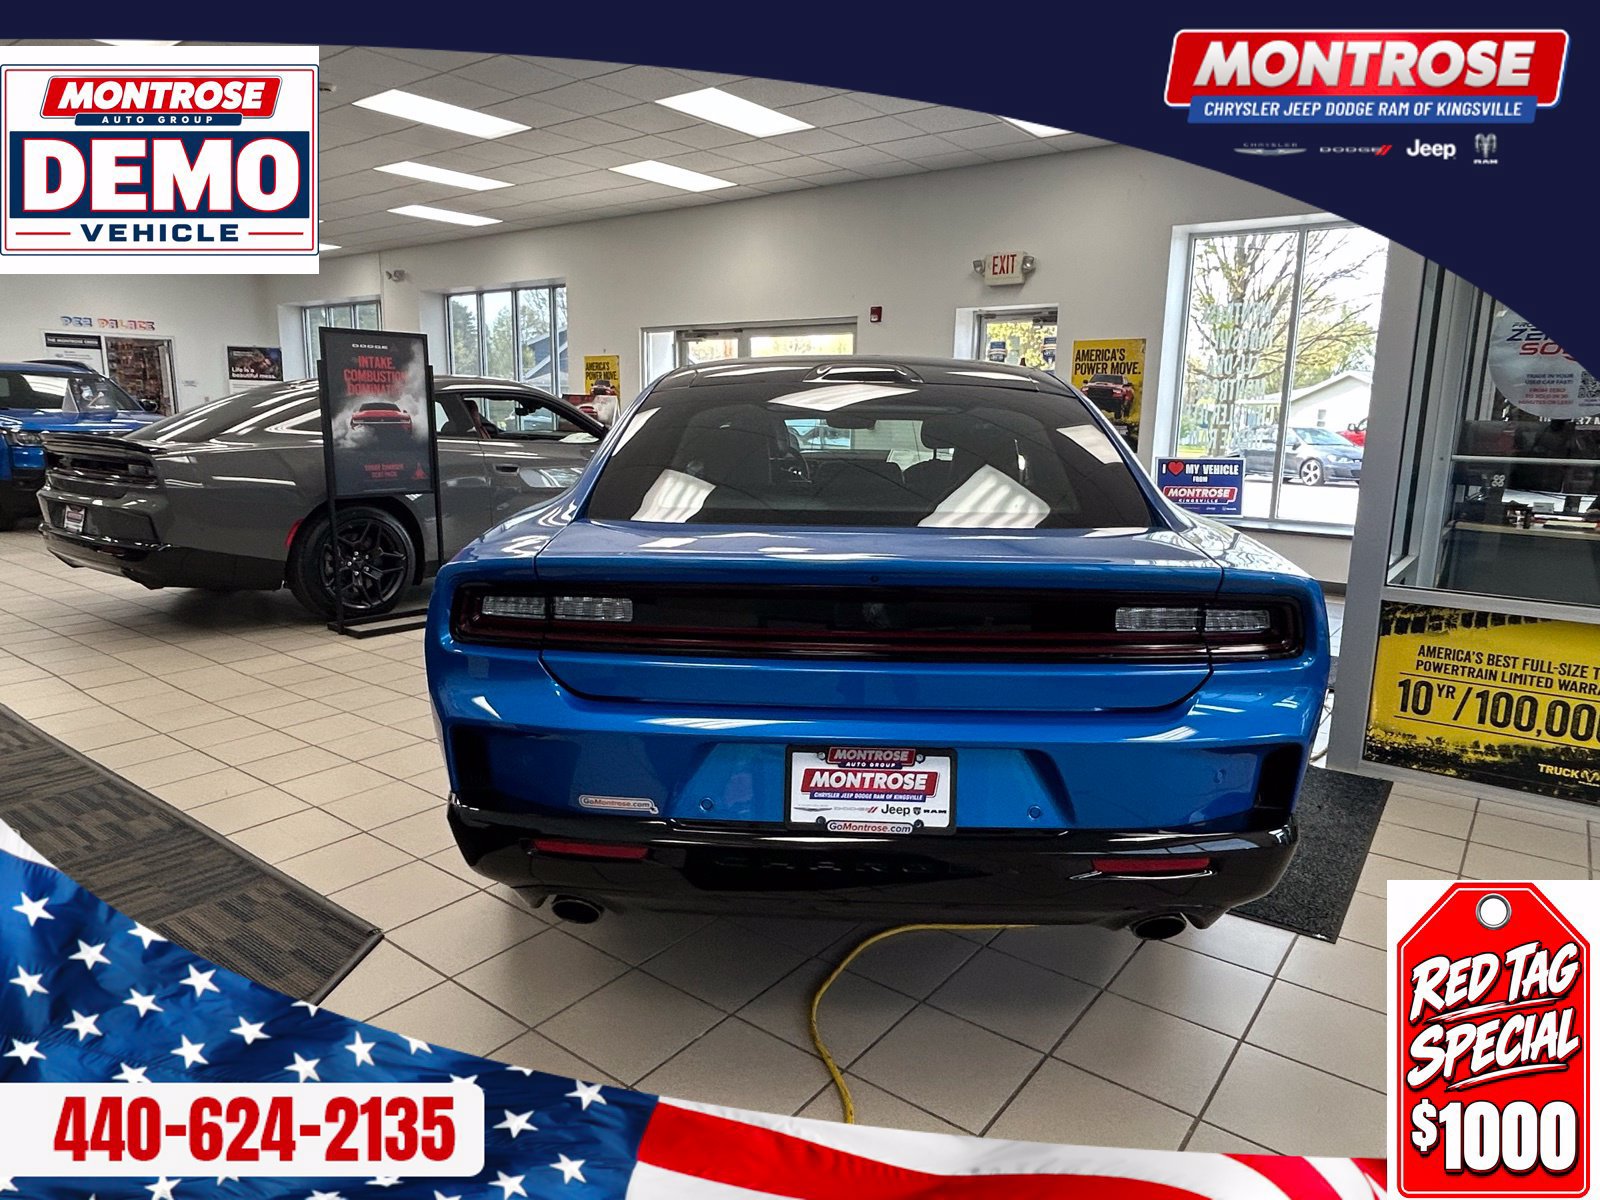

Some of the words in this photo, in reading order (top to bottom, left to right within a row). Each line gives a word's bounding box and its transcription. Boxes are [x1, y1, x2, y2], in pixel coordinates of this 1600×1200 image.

[992, 254, 1017, 275] EXIT
[1507, 328, 1548, 341] ZE
[1075, 348, 1126, 363] AMERICA'S
[586, 362, 610, 371] AMERICA'S
[1074, 362, 1107, 376] POWER
[1110, 362, 1142, 375] MOVE.
[586, 371, 602, 380] POWER
[1162, 463, 1167, 474] I
[1185, 464, 1200, 475] MY
[1202, 464, 1239, 475] VEHICLE
[1192, 475, 1208, 483] FROM
[1167, 488, 1231, 498] MONTROSE
[1417, 645, 1484, 664] AMERICA'S
[1487, 653, 1520, 670] BEST
[1522, 658, 1588, 679] FULL-SIZE
[1415, 660, 1498, 681] POWERTRAIN
[1501, 671, 1553, 689] LIMITED
[1475, 689, 1600, 744] 100,00
[834, 749, 910, 762] MONTROSE
[1537, 763, 1580, 779] TRUCK
[810, 771, 929, 791] MONTROSE
[583, 797, 650, 808] GoMontrose.com
[893, 793, 923, 801] KINGSVILLE
[881, 804, 911, 816] Jeep
[829, 822, 911, 833] GoMontrose.com
